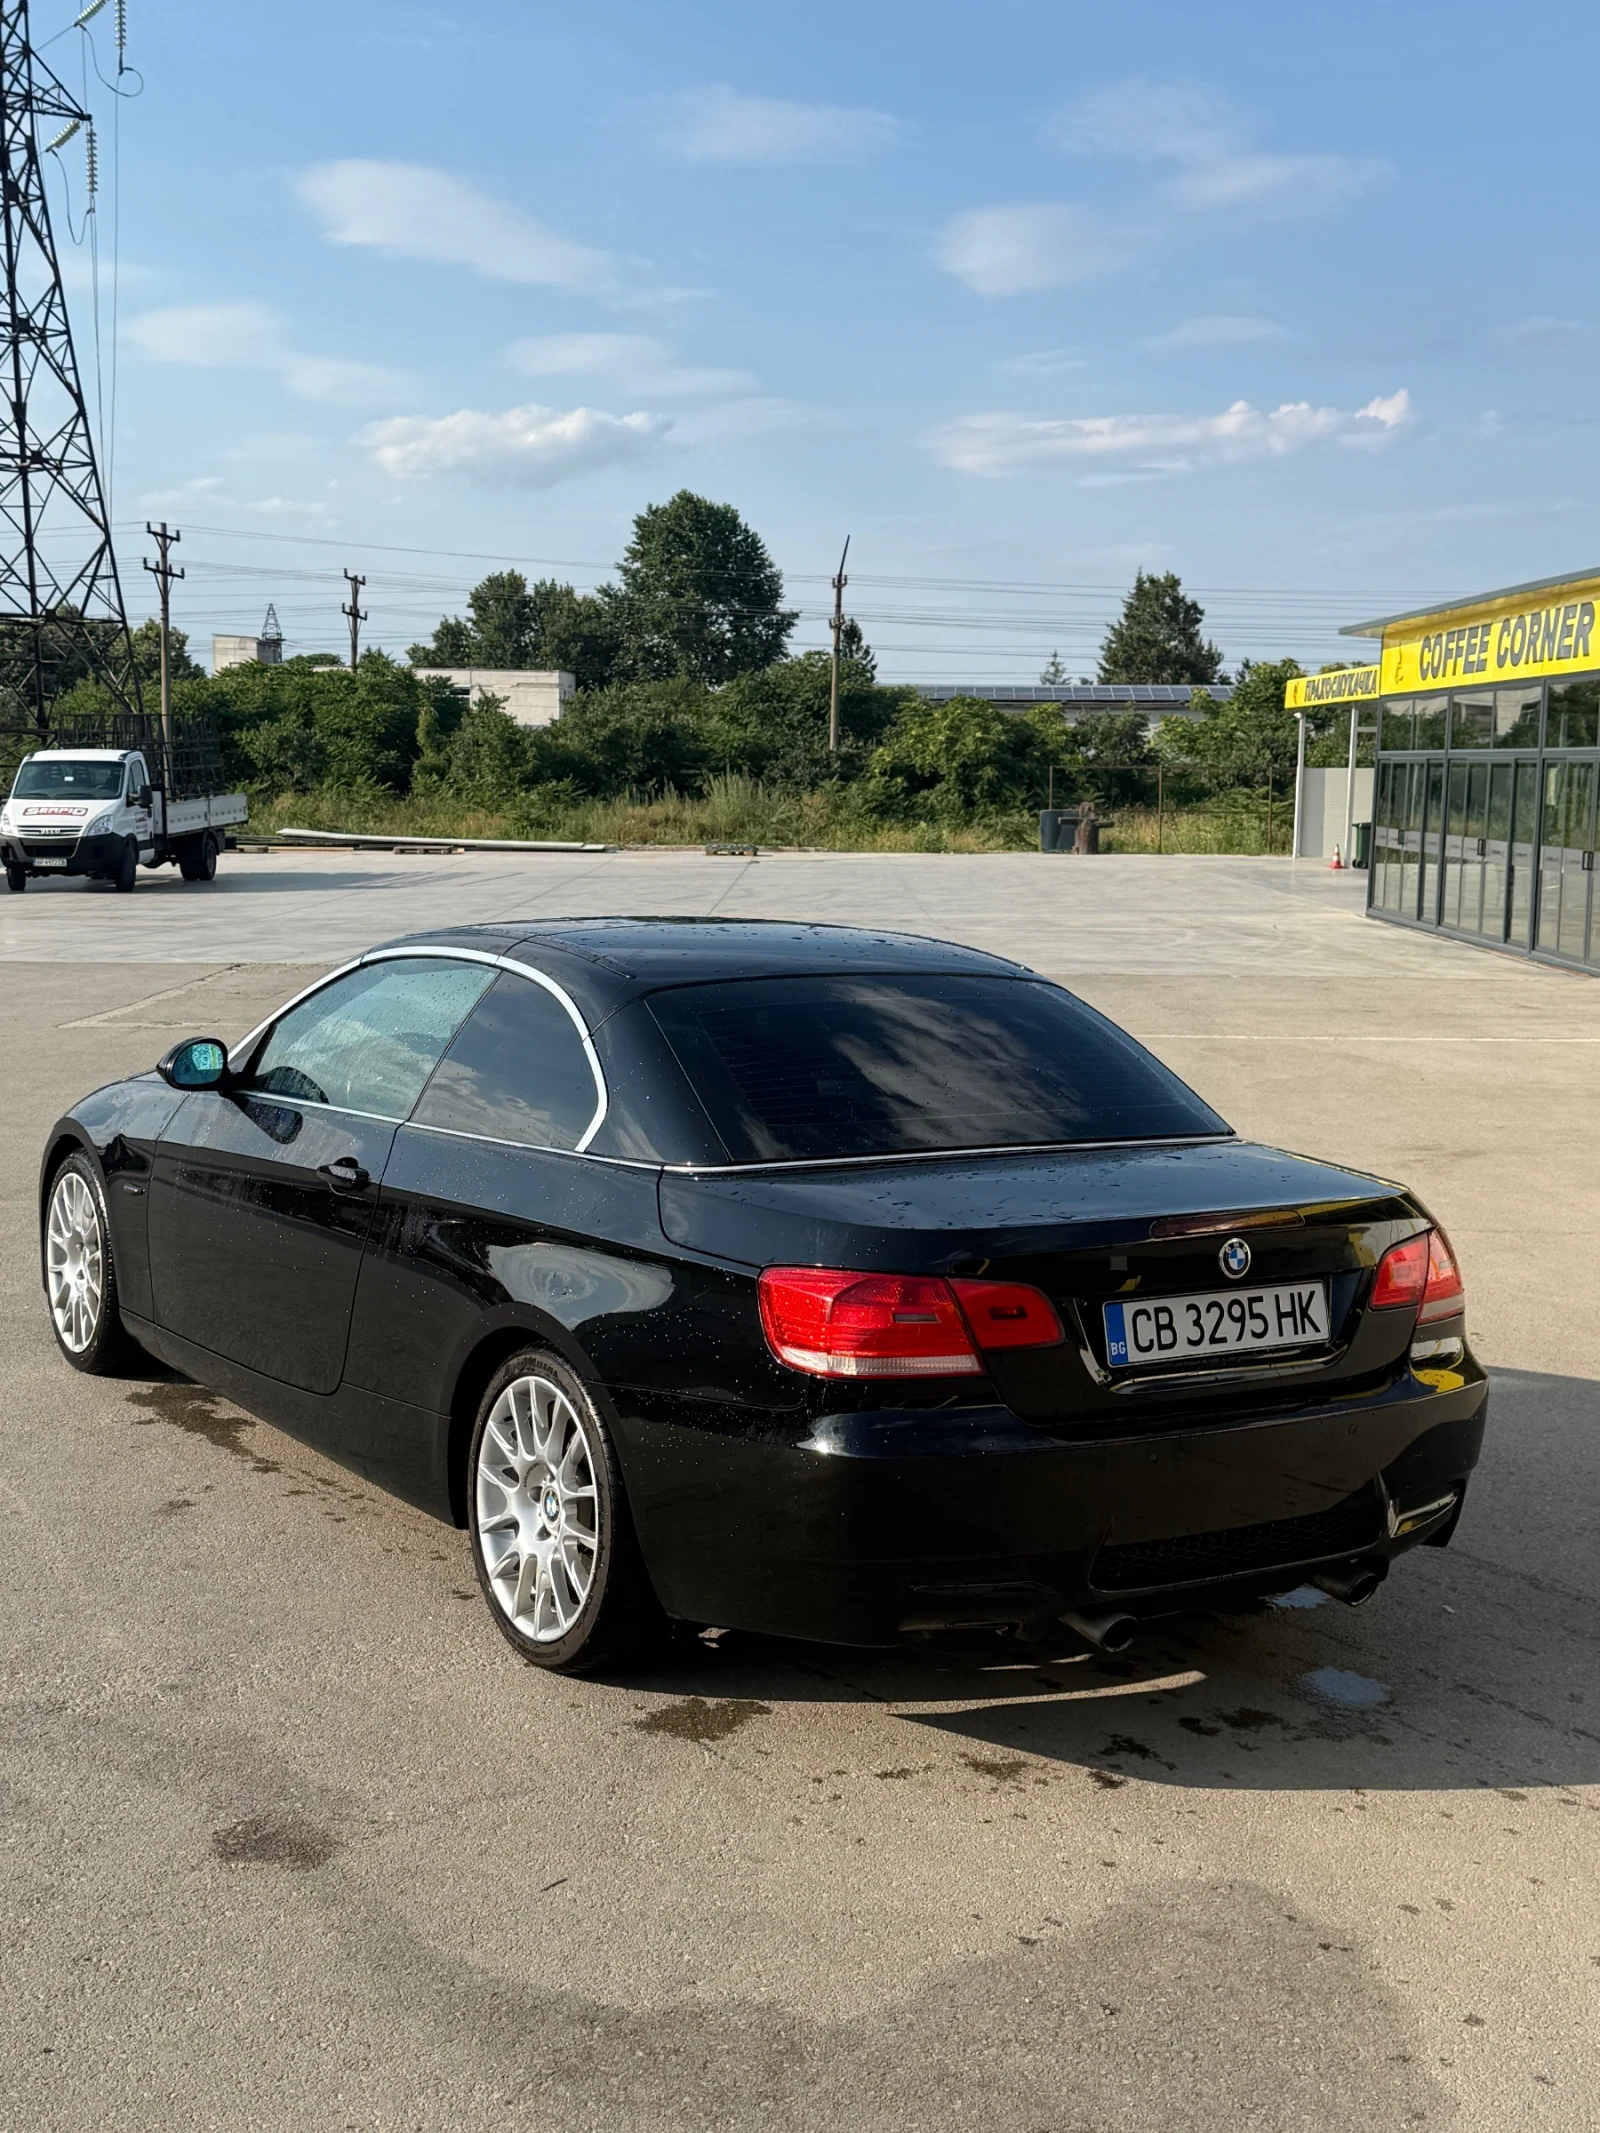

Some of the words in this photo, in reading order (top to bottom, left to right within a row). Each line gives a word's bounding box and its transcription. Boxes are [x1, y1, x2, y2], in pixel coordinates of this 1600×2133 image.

[1419, 623, 1492, 681] COFFEE
[1496, 601, 1595, 669] CORNER
[1110, 1341, 1126, 1356] BG
[1132, 1306, 1178, 1353] CB
[1186, 1296, 1269, 1346] 3295
[1274, 1290, 1321, 1337] HK
